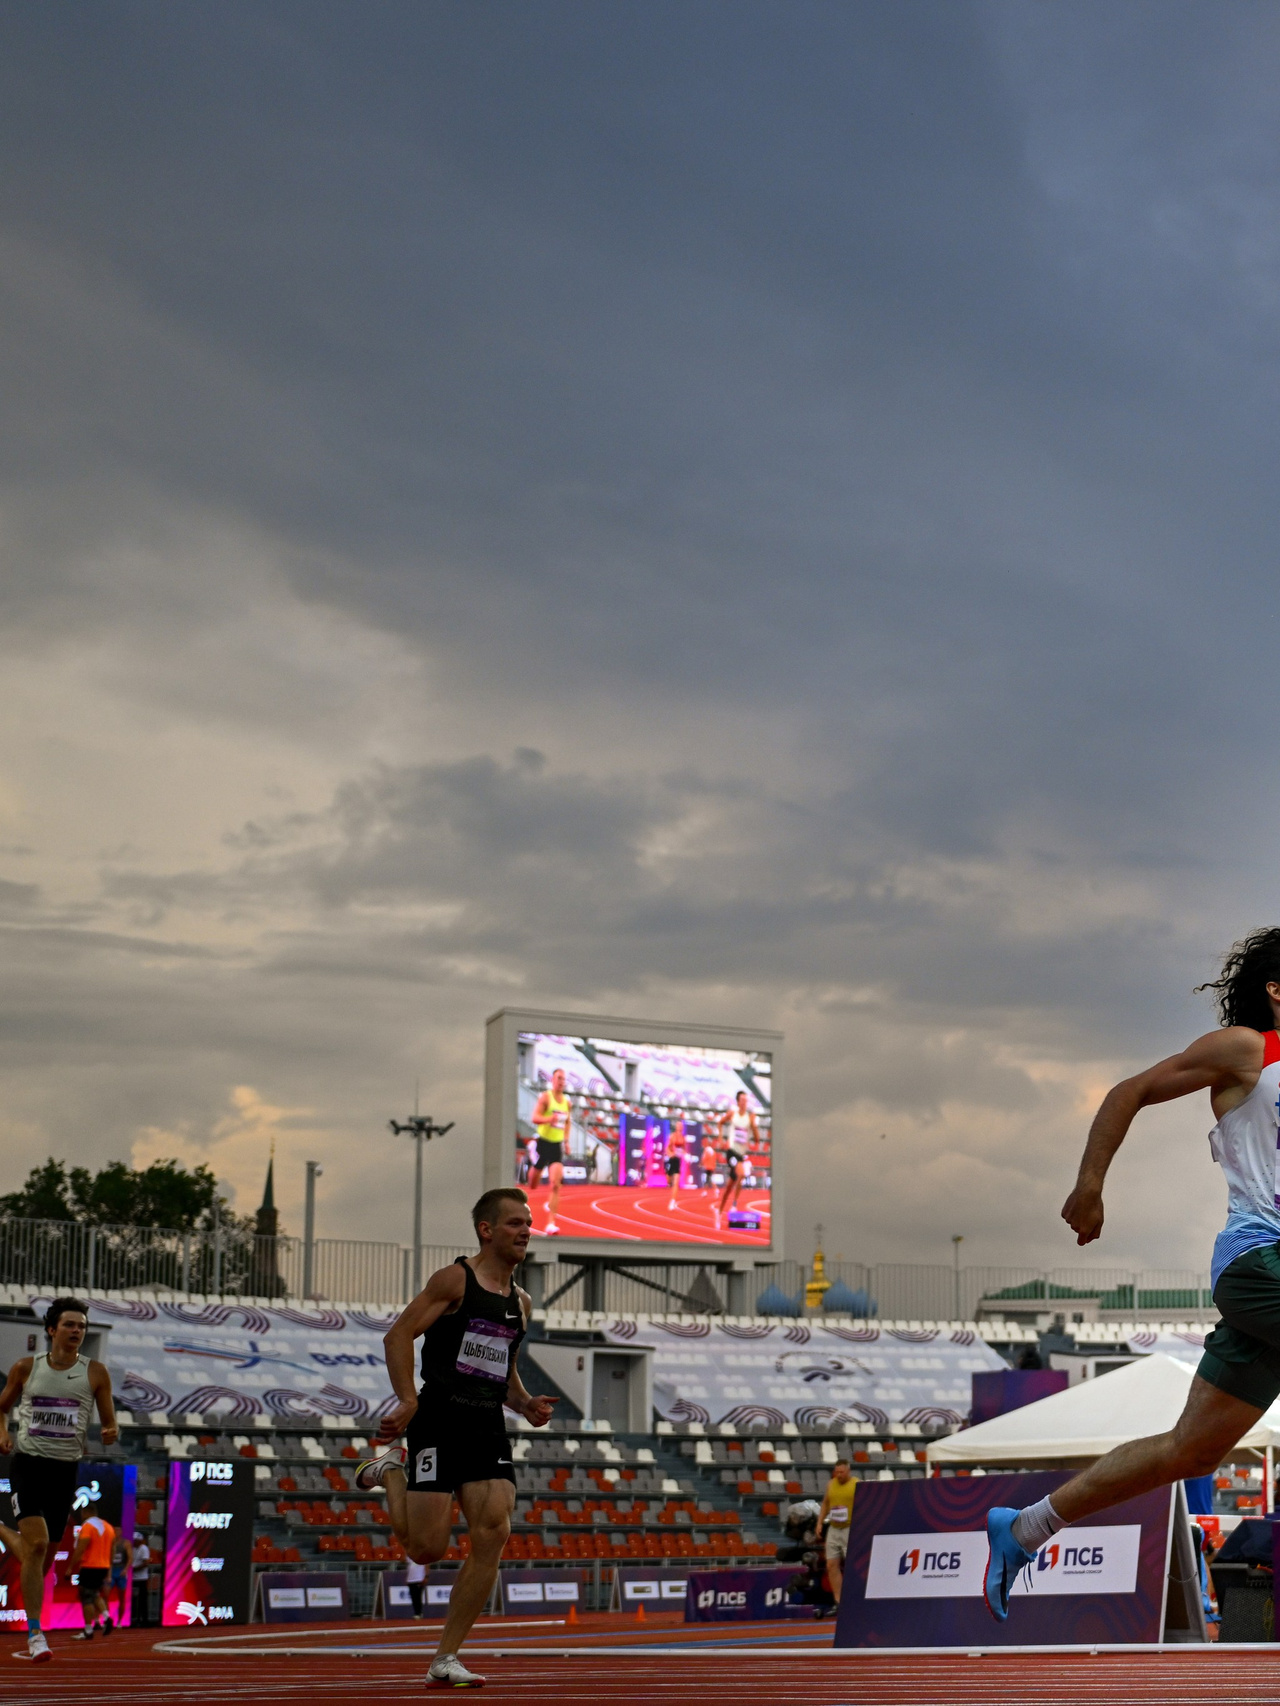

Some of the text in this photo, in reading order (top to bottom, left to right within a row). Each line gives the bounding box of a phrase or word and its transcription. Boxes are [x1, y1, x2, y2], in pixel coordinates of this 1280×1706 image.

[463, 1341, 508, 1365] ЦЫБУЛЕВСКИЙ
[32, 1411, 66, 1427] НИКИТИН
[206, 1462, 233, 1479] ПСБ
[421, 1455, 433, 1473] 5
[186, 1512, 233, 1529] FONBET
[923, 1552, 961, 1570] ПСБ
[1064, 1547, 1104, 1566] ПСБ
[717, 1592, 747, 1605] ПСБ
